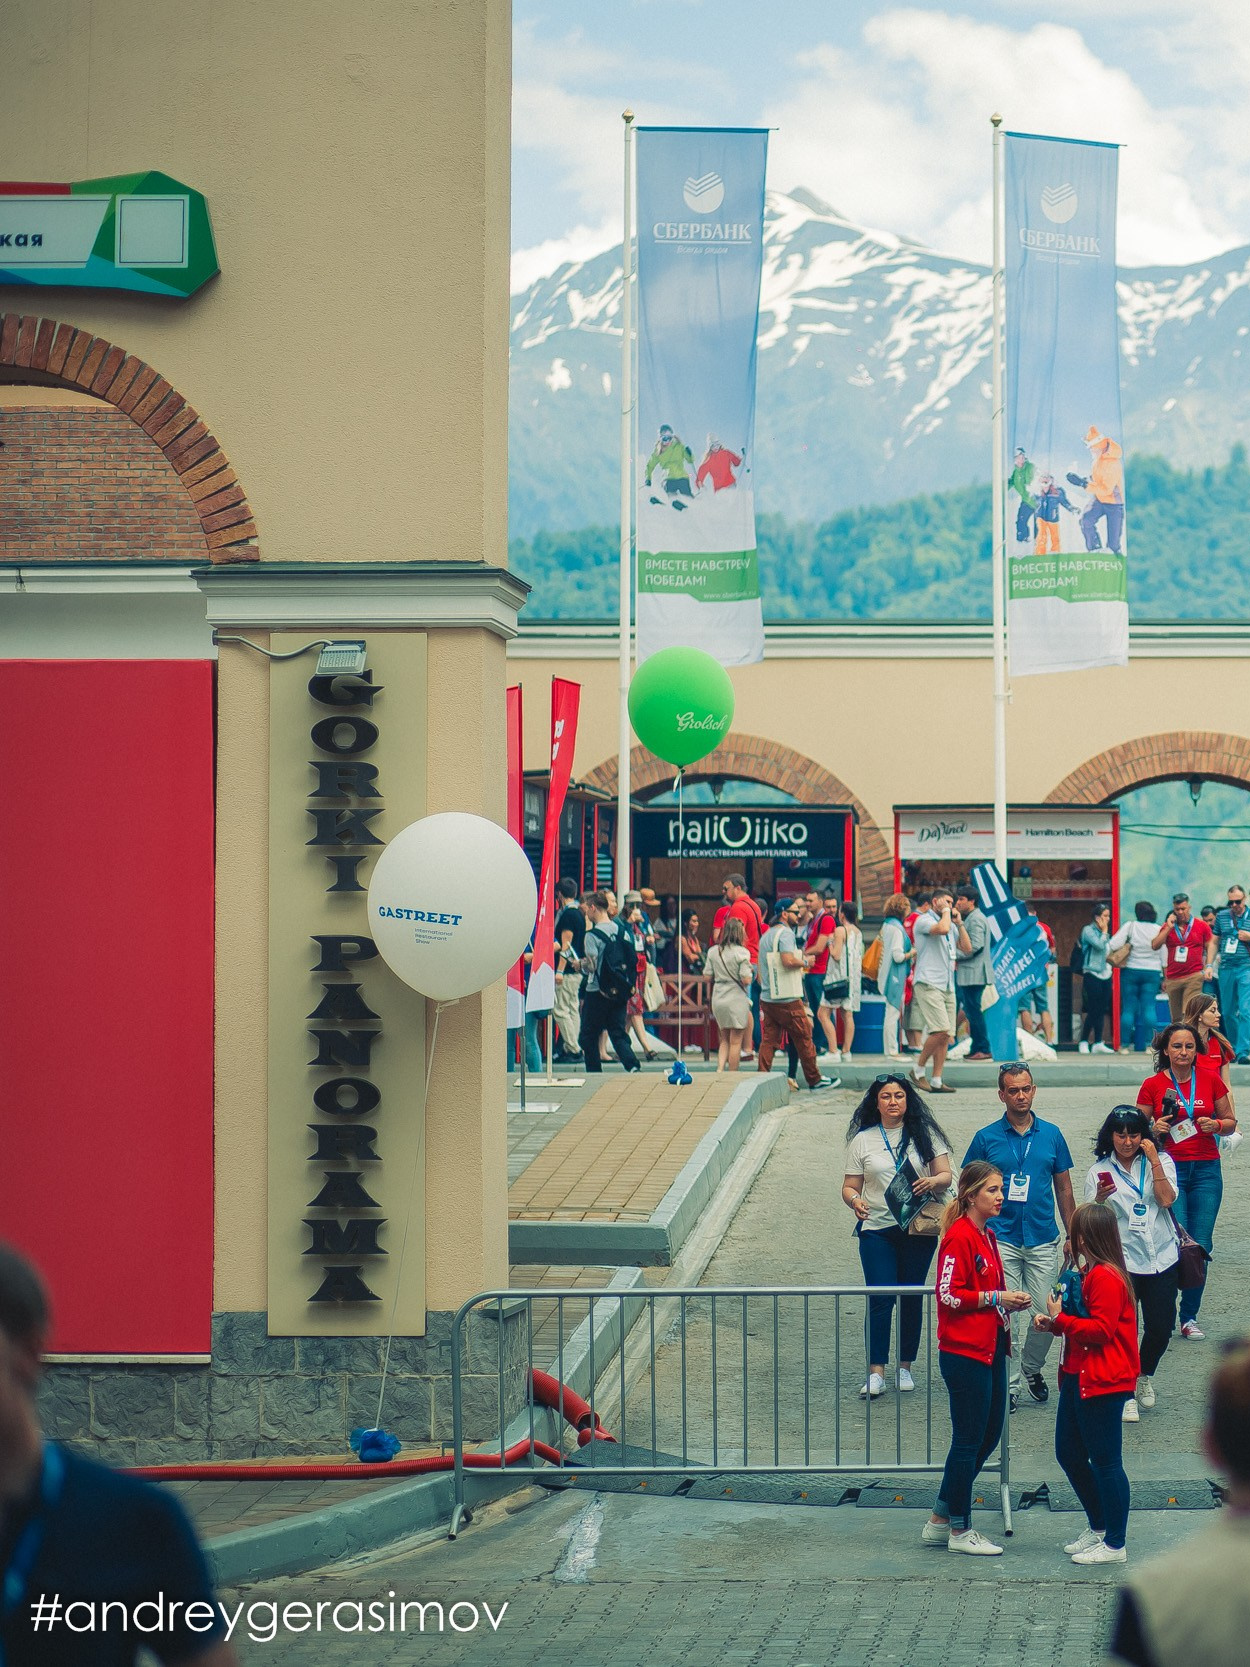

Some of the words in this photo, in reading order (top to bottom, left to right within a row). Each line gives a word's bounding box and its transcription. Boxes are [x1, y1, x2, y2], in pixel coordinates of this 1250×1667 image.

[653, 222, 752, 240] СБЕРБАНК
[1019, 227, 1100, 253] СБЕРБАНК
[645, 559, 689, 571] ВМЕСТЕ
[1012, 562, 1057, 575] ВМЕСТЕ
[1059, 560, 1123, 571] НАВСТРЕЧУ
[645, 574, 707, 587] ПОБЕДАМ!
[1012, 576, 1079, 590] РЕКОРДАМ!
[676, 711, 728, 732] Grolsch
[305, 669, 386, 893] GORKI
[1025, 827, 1064, 838] Hamilton
[1065, 827, 1094, 838] Beach
[378, 906, 463, 926] GASTREET
[1002, 949, 1036, 989] SHAKE!
[301, 934, 389, 1303] PANORAMA
